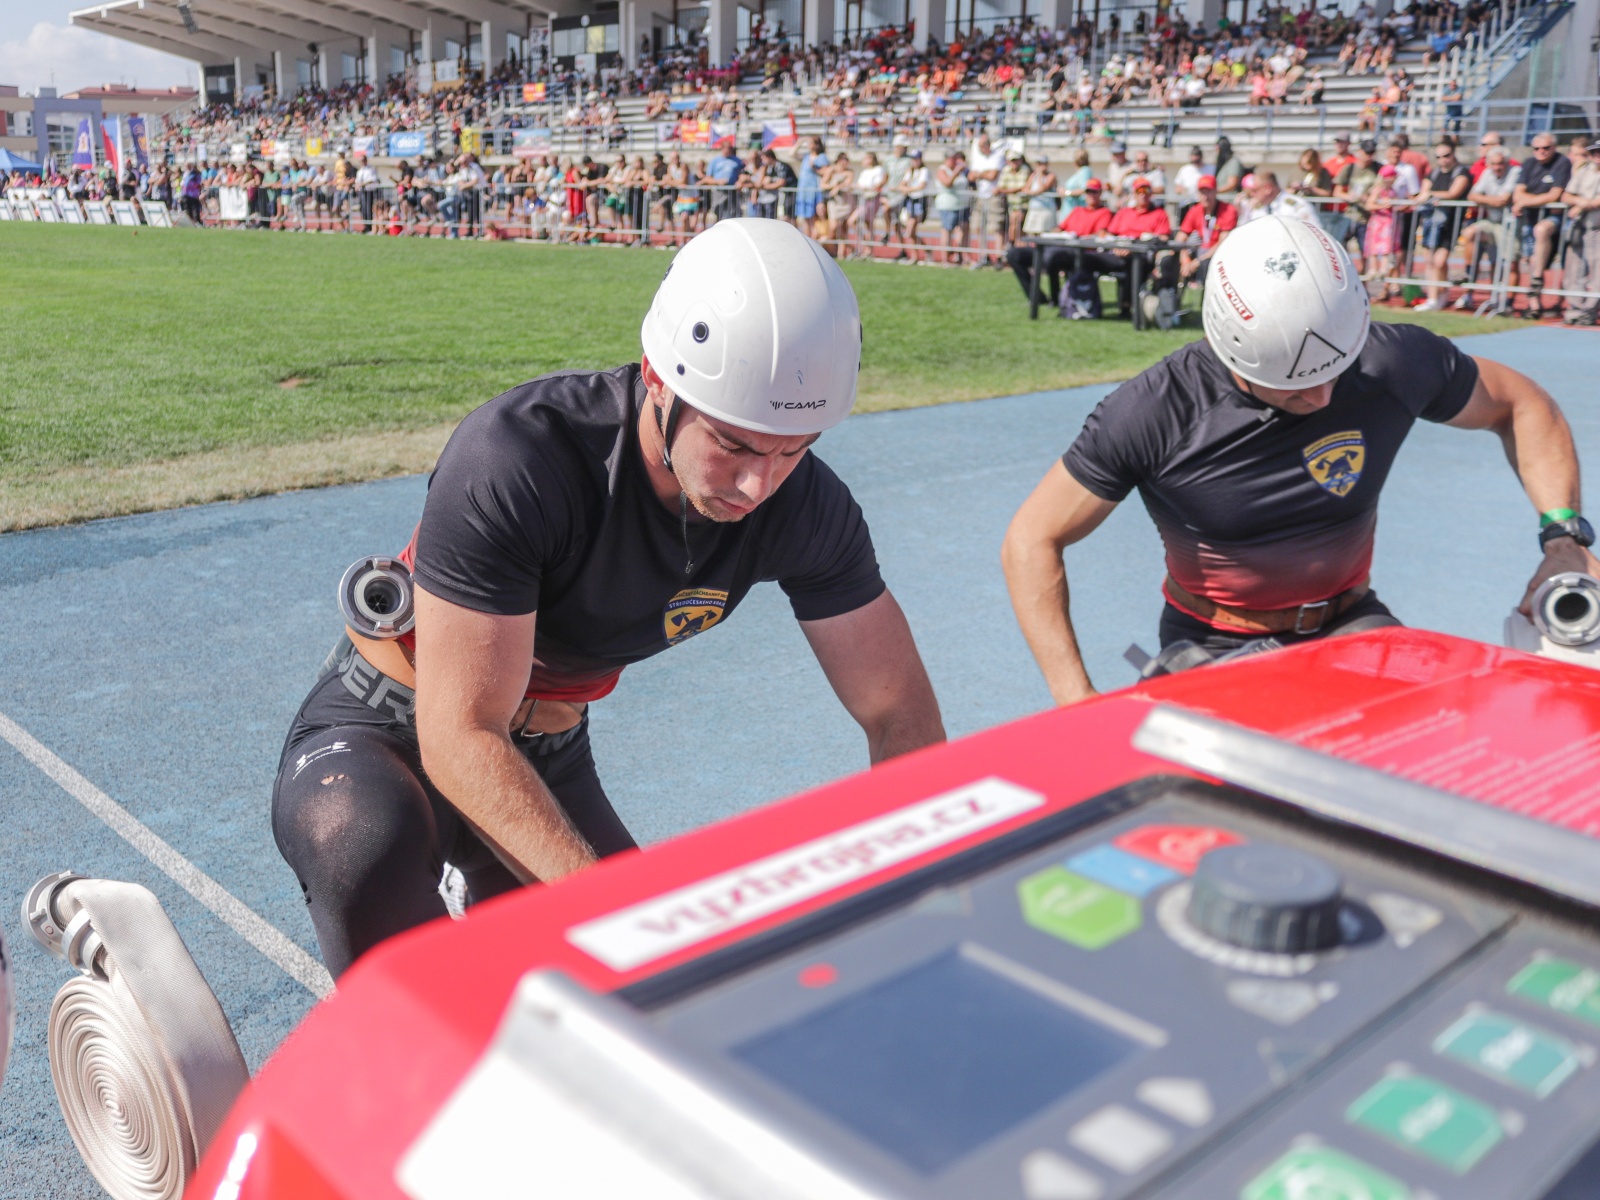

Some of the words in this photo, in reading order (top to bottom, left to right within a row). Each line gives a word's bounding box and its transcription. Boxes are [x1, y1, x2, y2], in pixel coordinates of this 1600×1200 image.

[1216, 261, 1229, 283] FIRE
[1223, 282, 1253, 320] SPORT
[1297, 355, 1341, 378] CAMP
[784, 399, 827, 410] CAMP
